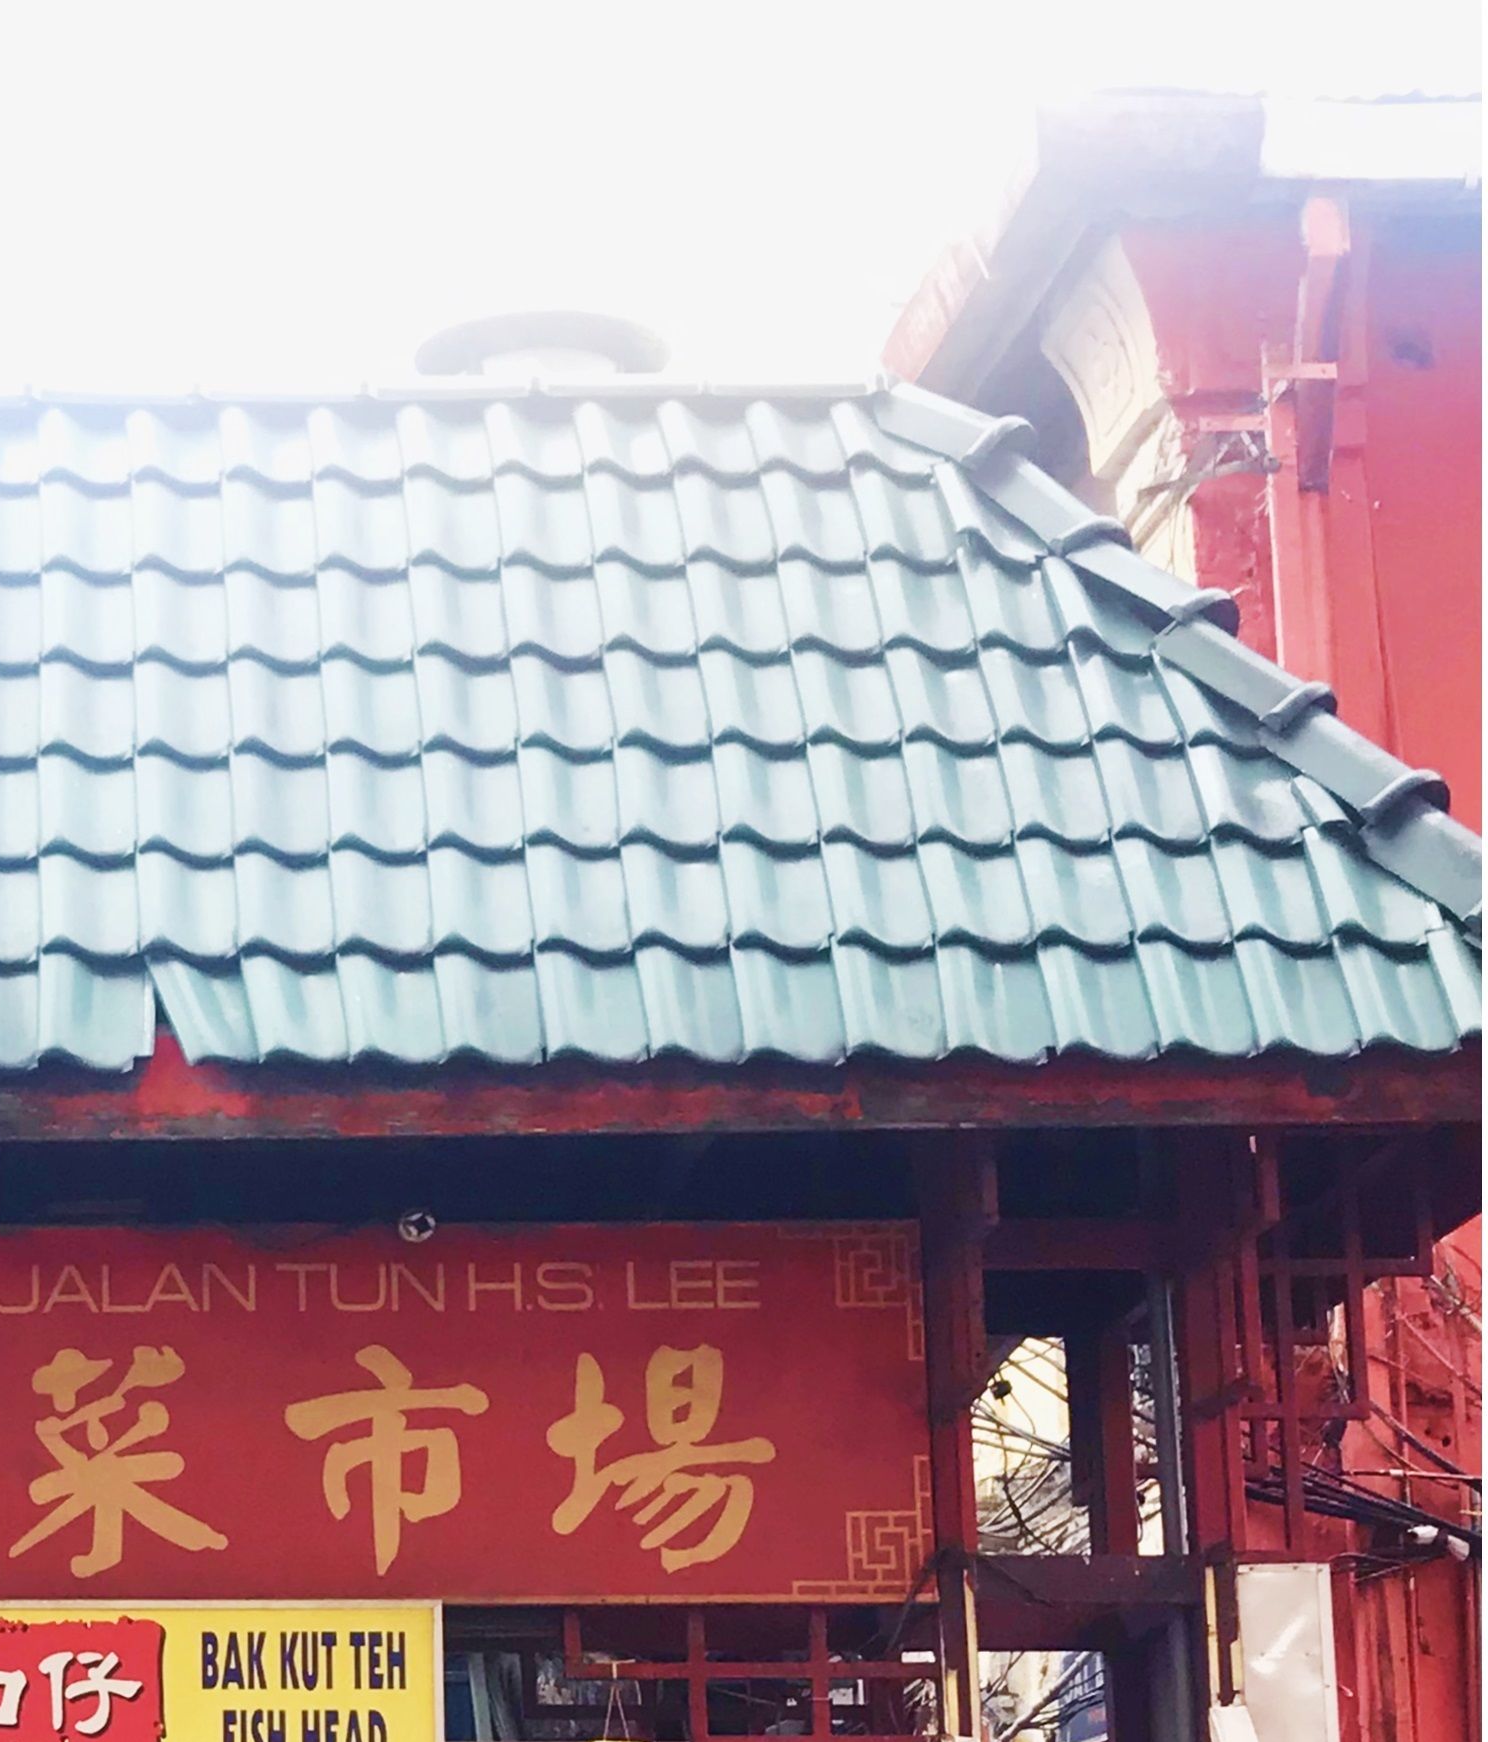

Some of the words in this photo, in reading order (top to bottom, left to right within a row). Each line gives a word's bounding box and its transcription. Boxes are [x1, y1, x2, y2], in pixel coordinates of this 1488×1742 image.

[275, 1262, 447, 1312] TUN
[626, 1260, 762, 1310] LEE
[201, 1631, 267, 1690] BAK
[279, 1631, 338, 1691] KUT
[349, 1631, 407, 1690] TEH
